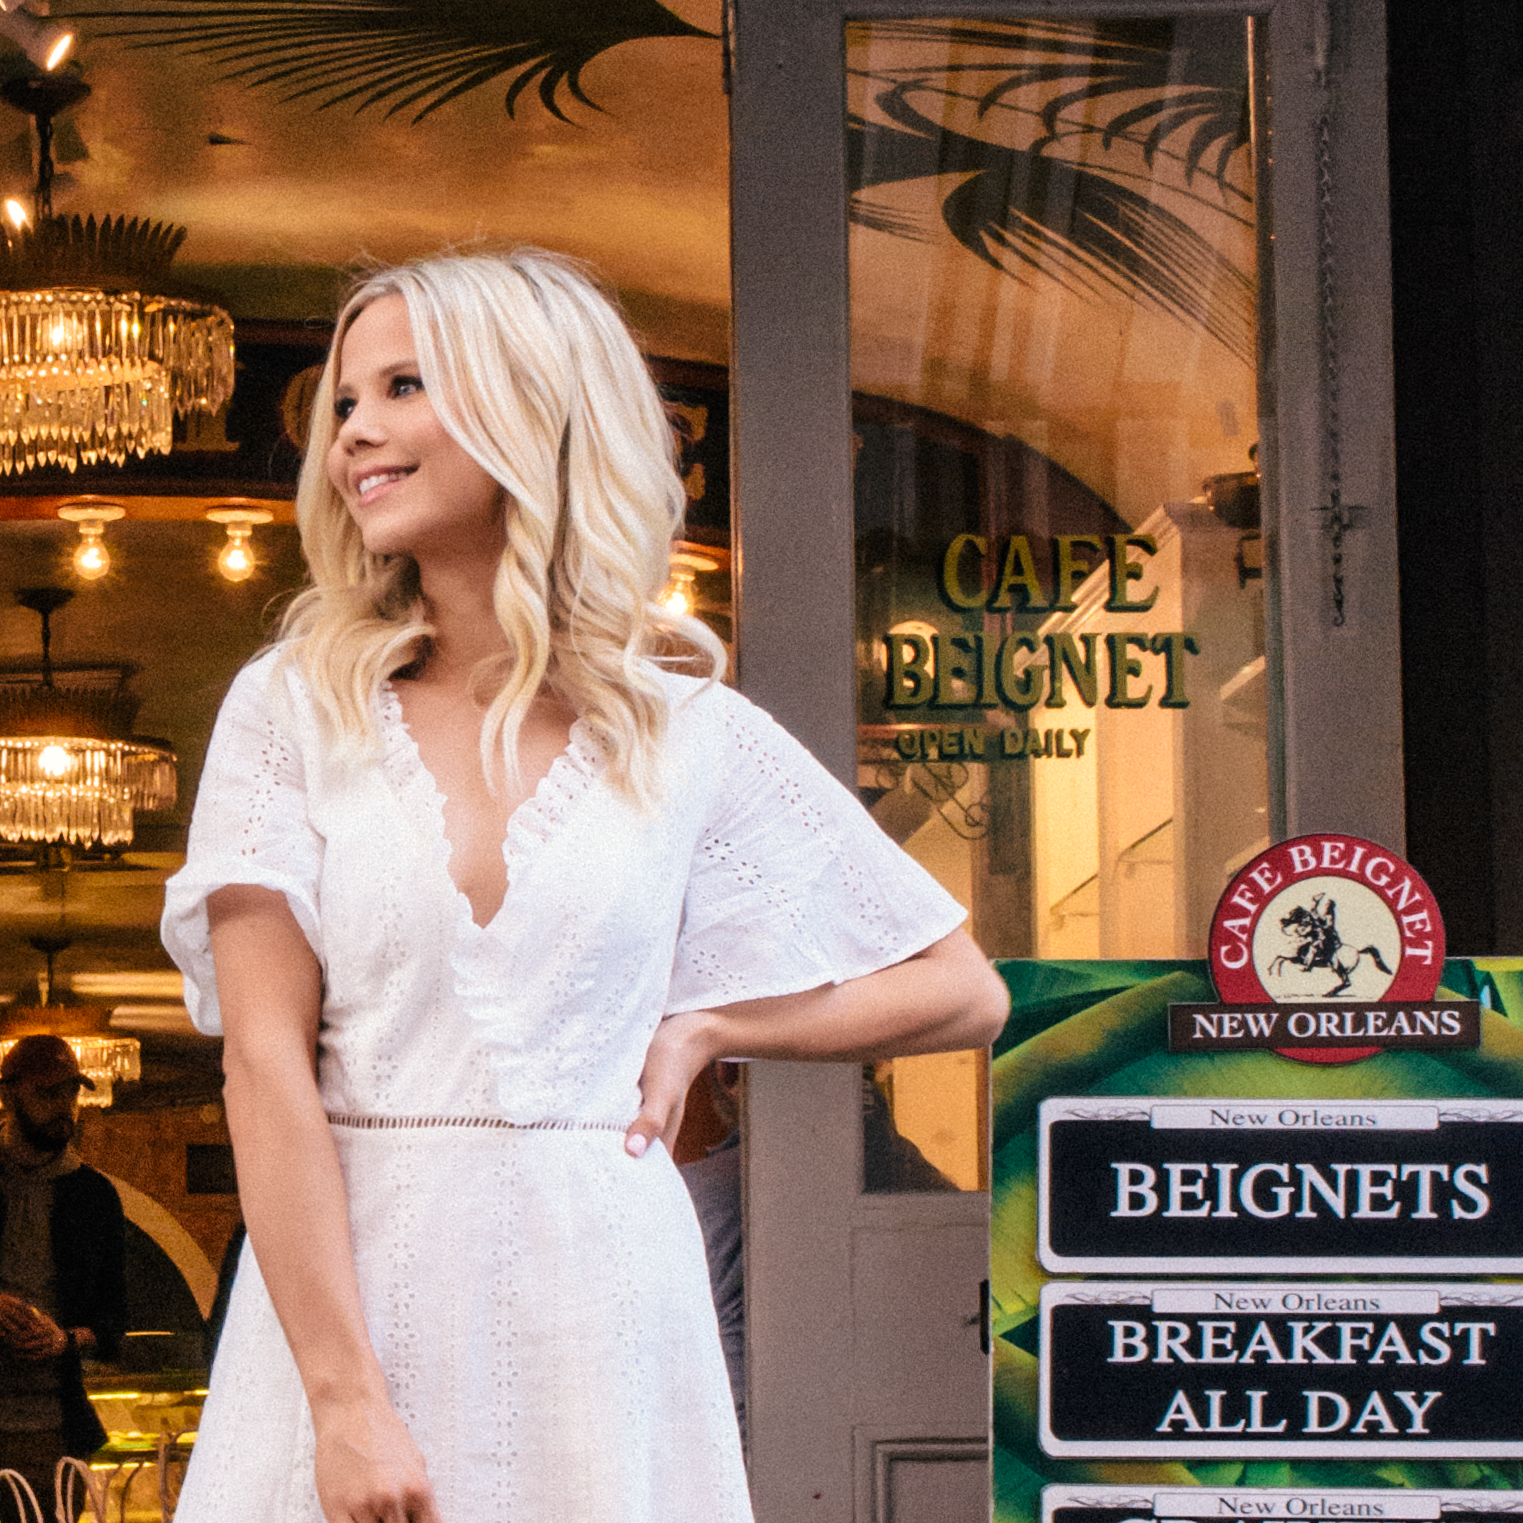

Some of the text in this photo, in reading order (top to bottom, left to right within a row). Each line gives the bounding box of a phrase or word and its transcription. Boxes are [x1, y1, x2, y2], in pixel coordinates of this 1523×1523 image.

[938, 534, 1159, 613] CAFE
[883, 632, 1200, 711] BEIGNET
[896, 728, 1090, 758] OPEN DAILY
[1220, 841, 1433, 970] CAFE BEIGNET
[1192, 1011, 1461, 1039] NEW ORLEANS
[1209, 1109, 1376, 1127] New Orleans
[1110, 1162, 1491, 1220] BEIGNETS
[1213, 1293, 1379, 1311] New Orleans
[1107, 1320, 1496, 1365] BREAKFAST
[1156, 1390, 1442, 1434] ALL DAY
[1218, 1497, 1384, 1516] New Orleans
